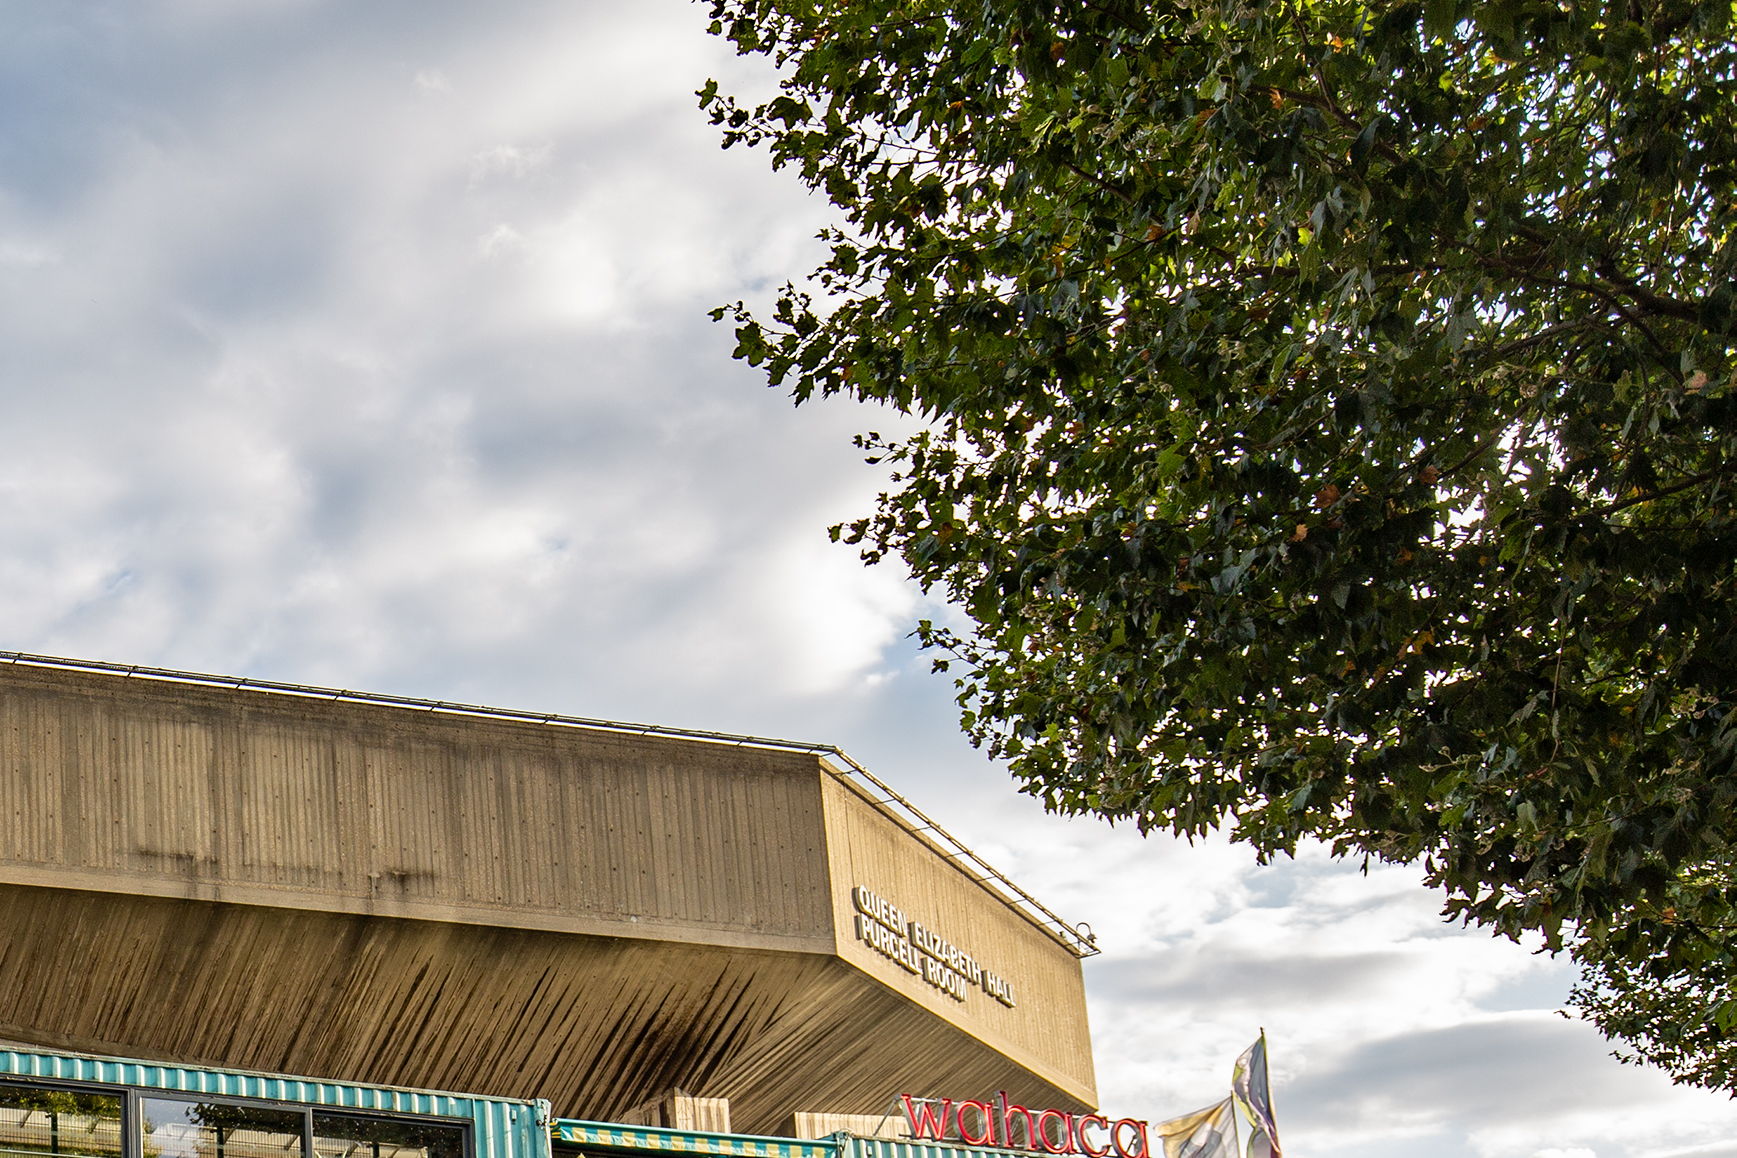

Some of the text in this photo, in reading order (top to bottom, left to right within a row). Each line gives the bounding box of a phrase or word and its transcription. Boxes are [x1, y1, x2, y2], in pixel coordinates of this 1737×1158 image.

[856, 885, 1016, 1007] QUEEN ELIZABETH HALL
[857, 913, 968, 1002] PURCELL ROOM
